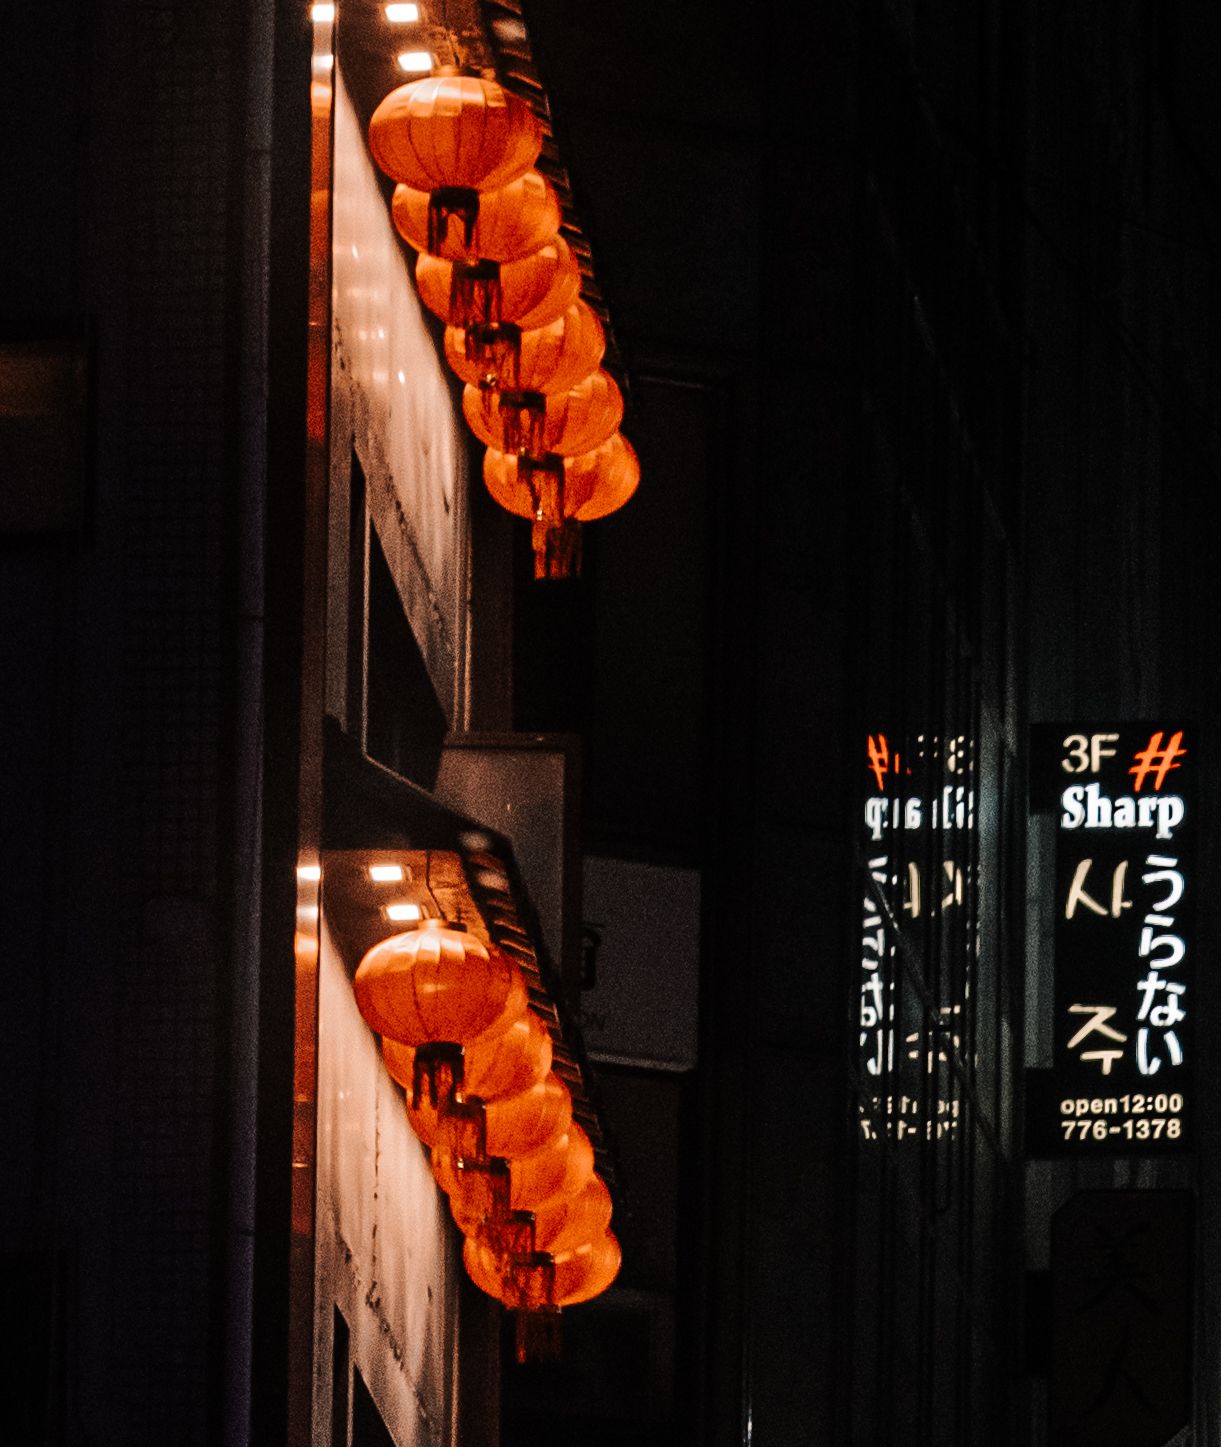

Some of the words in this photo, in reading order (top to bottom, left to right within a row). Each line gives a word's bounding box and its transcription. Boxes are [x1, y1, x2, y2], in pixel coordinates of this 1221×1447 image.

[1061, 734, 1120, 773] 3F
[1060, 783, 1185, 839] Sharp
[1065, 858, 1133, 1076] 사주
[1136, 855, 1186, 1076] うらない
[1060, 1119, 1181, 1141] 776-1378
